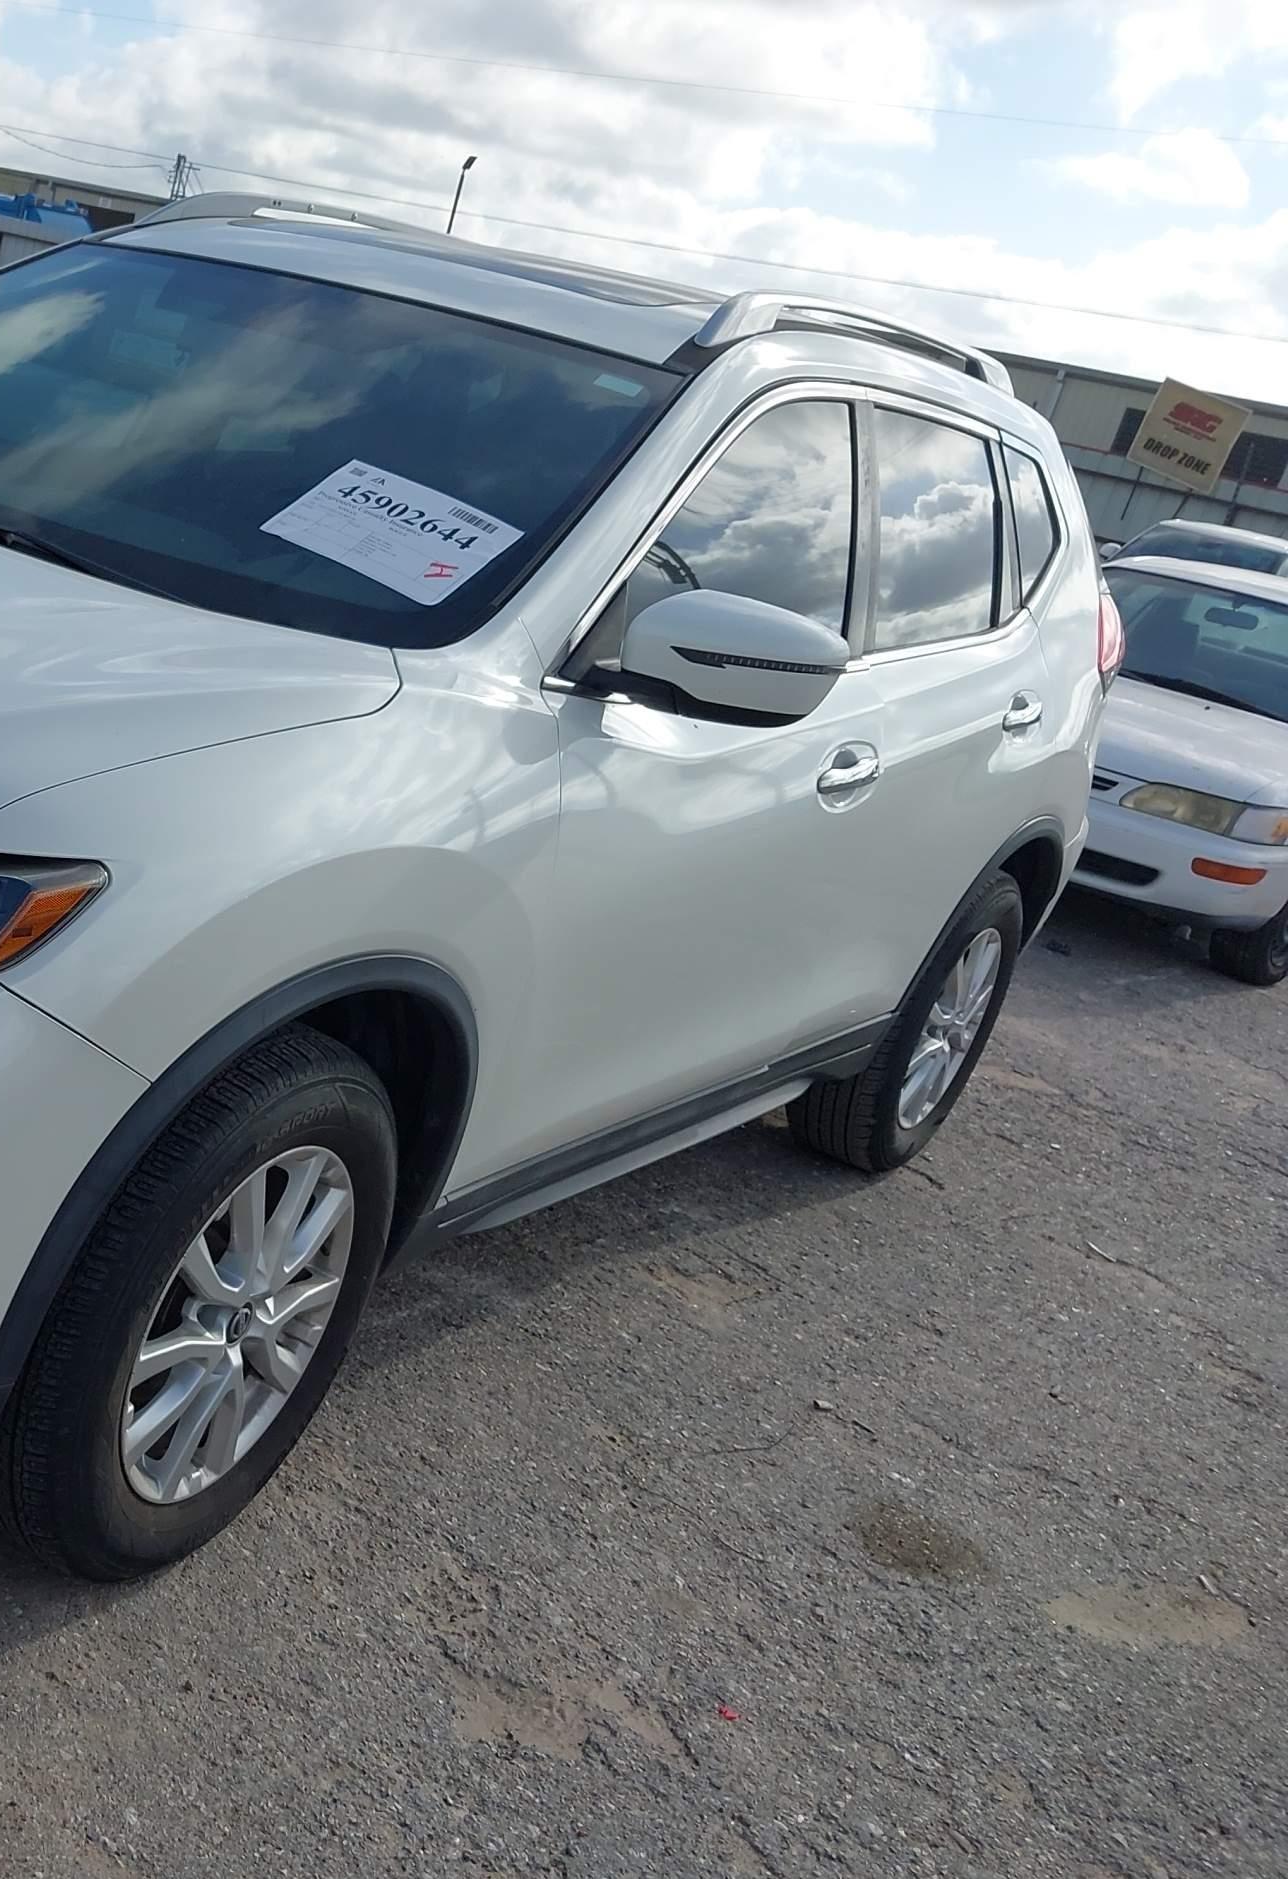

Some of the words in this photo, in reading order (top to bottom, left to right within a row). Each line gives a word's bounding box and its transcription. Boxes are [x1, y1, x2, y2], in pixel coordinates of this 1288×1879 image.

[1143, 437, 1178, 460] DROP
[1178, 452, 1212, 475] ZONE
[337, 485, 479, 550] 45902644
